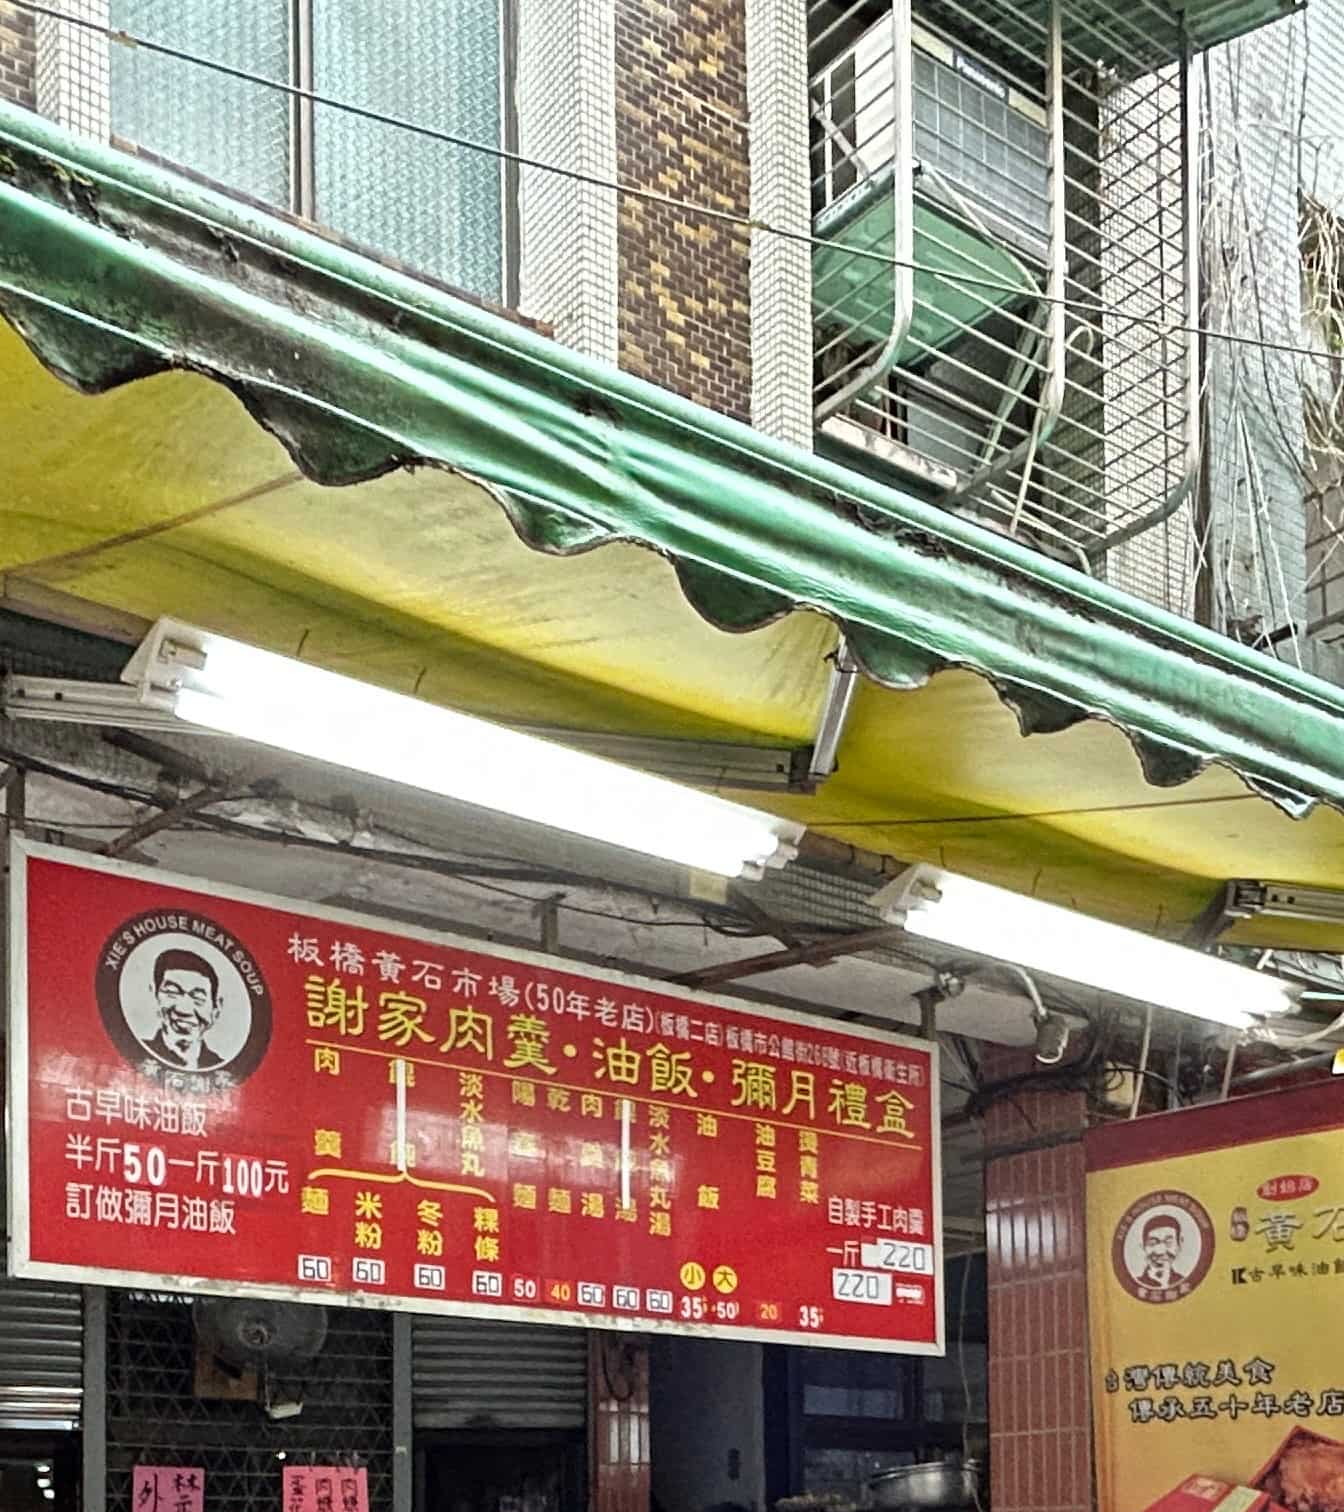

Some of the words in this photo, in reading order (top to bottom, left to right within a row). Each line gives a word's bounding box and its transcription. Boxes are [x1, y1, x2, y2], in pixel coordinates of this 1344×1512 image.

[105, 930, 135, 970] XIE'S
[135, 915, 189, 937] HOUSE
[192, 919, 233, 950] MEAT
[231, 949, 264, 997] SOUP
[64, 1085, 208, 1138] 古早味油飯
[755, 1122, 777, 1200] 油豆腐
[64, 1181, 237, 1236] 訂做彌月油飯
[355, 1191, 383, 1250] 米粉
[417, 1199, 444, 1257] 冬粉
[837, 1271, 880, 1300] 220
[882, 1241, 926, 1272] 220
[302, 1259, 330, 1280] 60
[356, 1261, 383, 1282] 60
[418, 1266, 444, 1287] 60
[476, 1274, 500, 1295] 60
[514, 1279, 537, 1299] 50
[551, 1283, 572, 1301] 40
[580, 1285, 604, 1306] 60
[616, 1288, 638, 1310] 60
[649, 1291, 671, 1312] 60
[761, 1303, 778, 1320] 20
